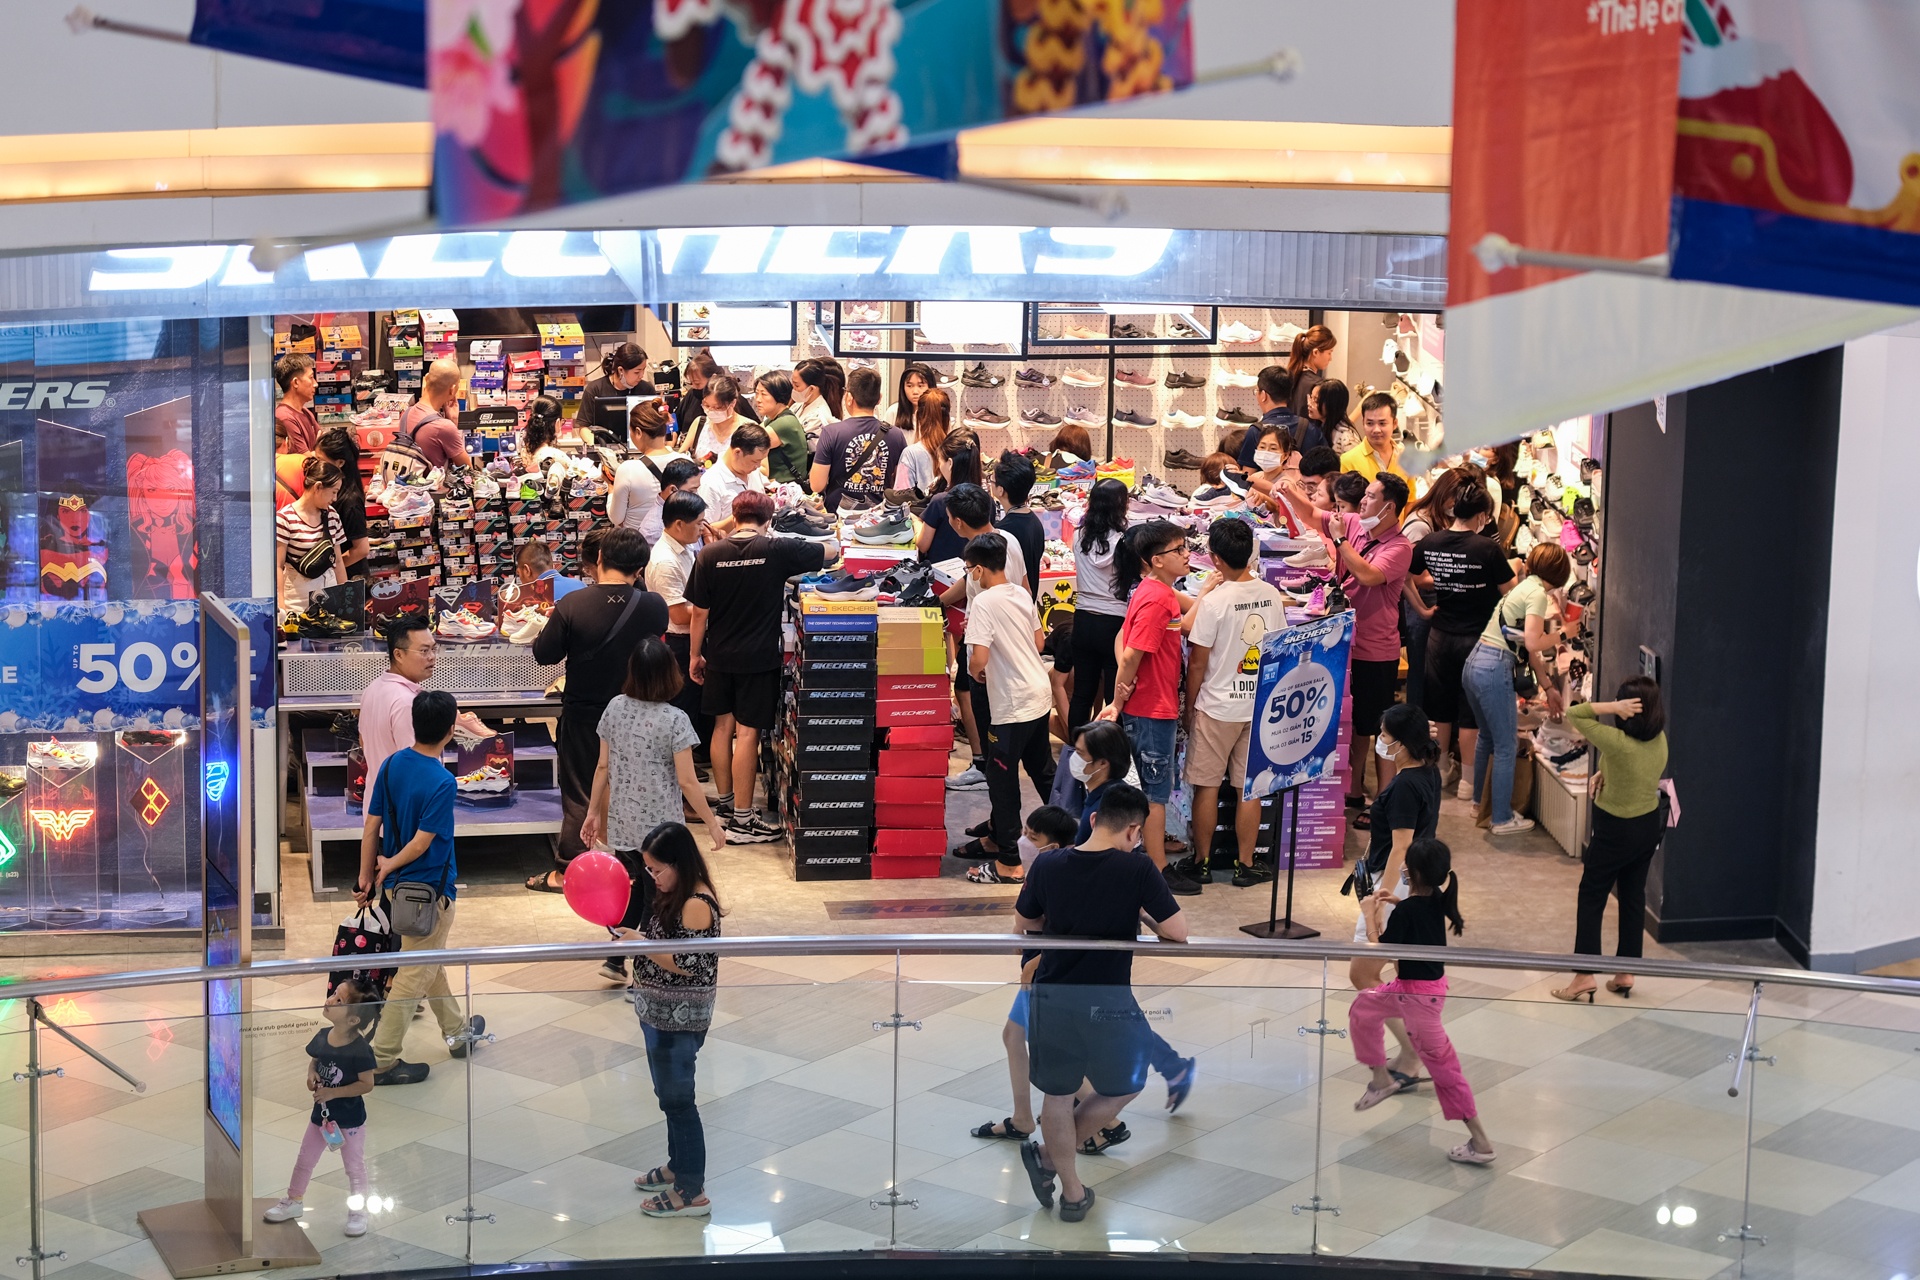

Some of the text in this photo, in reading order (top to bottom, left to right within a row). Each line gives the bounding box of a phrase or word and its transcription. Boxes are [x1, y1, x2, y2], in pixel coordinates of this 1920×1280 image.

[843, 481, 864, 490] FREE
[865, 484, 885, 492] SOUL
[716, 558, 766, 568] SKECHERS
[1234, 603, 1251, 611] SORRY
[1260, 599, 1273, 607] LATE
[1283, 625, 1334, 645] SKECHERS
[76, 641, 201, 694] 50%
[811, 662, 868, 670] SKECHERS
[1239, 681, 1257, 692] DID
[1294, 680, 1312, 688] SEASON
[1268, 683, 1328, 724] 50%
[1269, 743, 1280, 751] MUA
[808, 801, 865, 809] SKECHERS
[838, 902, 1015, 914] SKECHE
